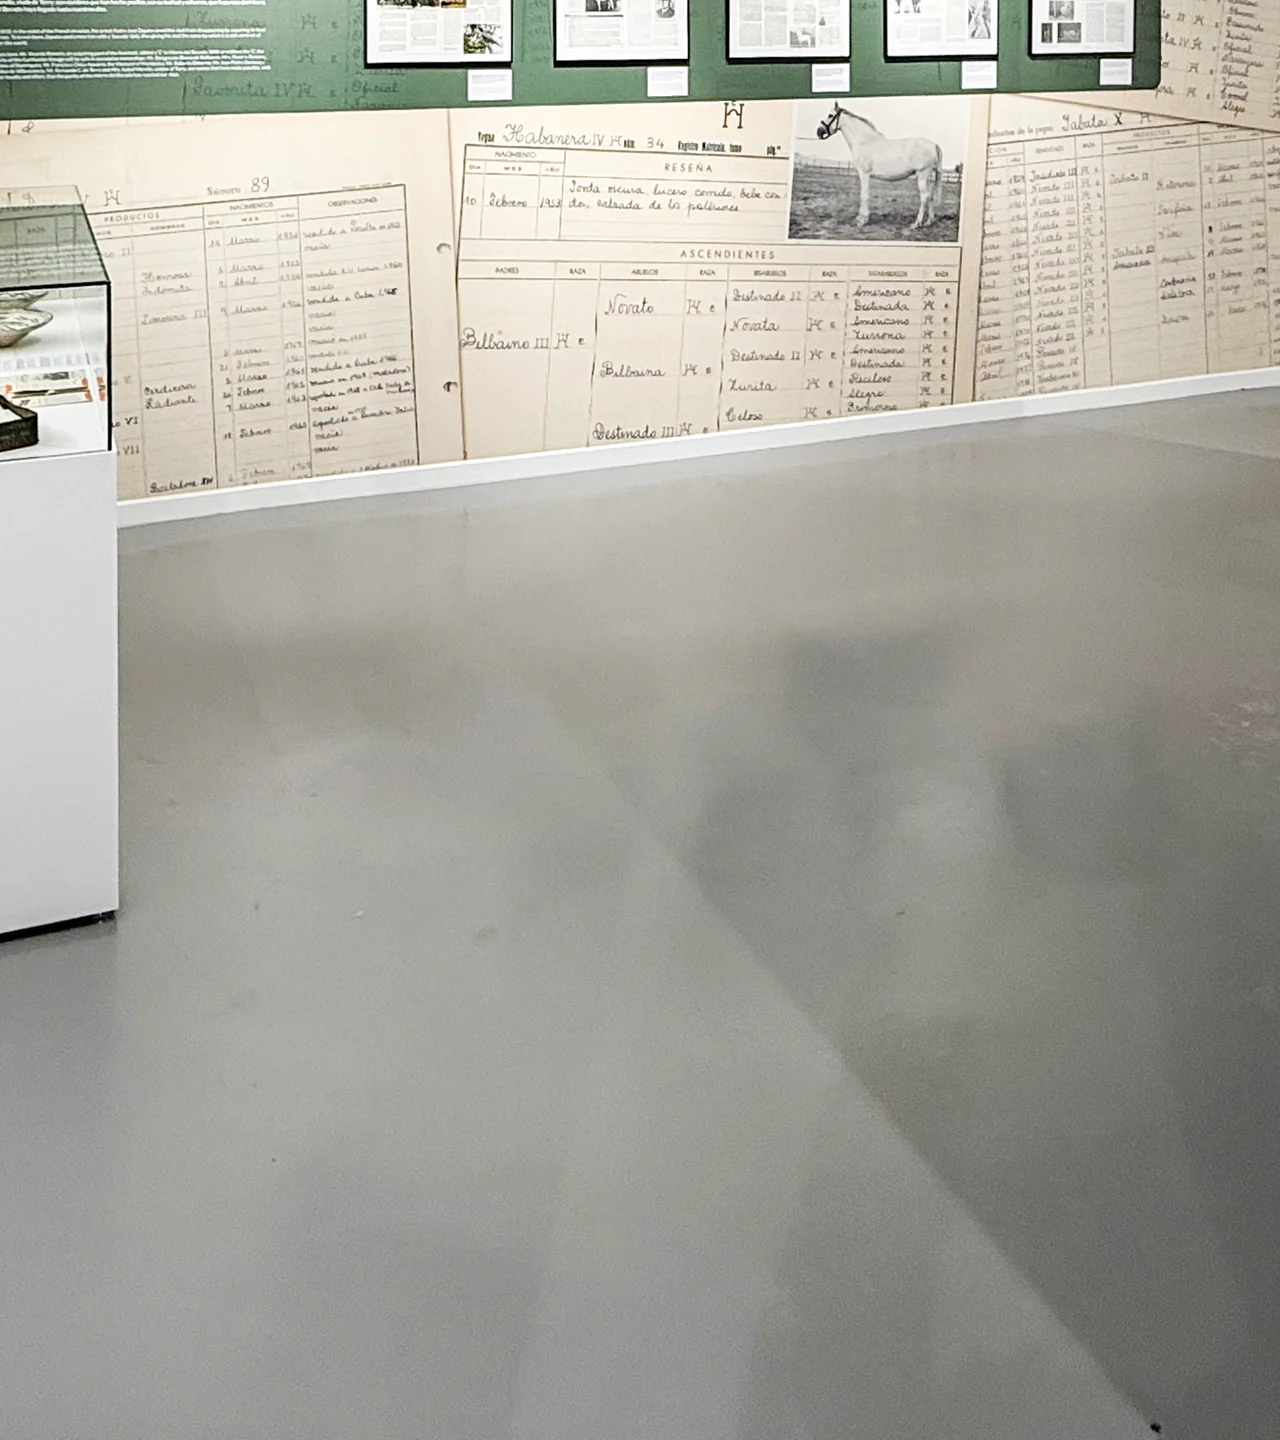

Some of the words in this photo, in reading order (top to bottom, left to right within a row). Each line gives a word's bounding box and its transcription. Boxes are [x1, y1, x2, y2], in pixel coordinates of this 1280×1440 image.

[503, 123, 590, 147] Habanera
[647, 137, 665, 148] 34
[664, 161, 713, 173] RESEÑA
[250, 176, 270, 193] 89
[680, 249, 775, 260] ASCENDIENTES
